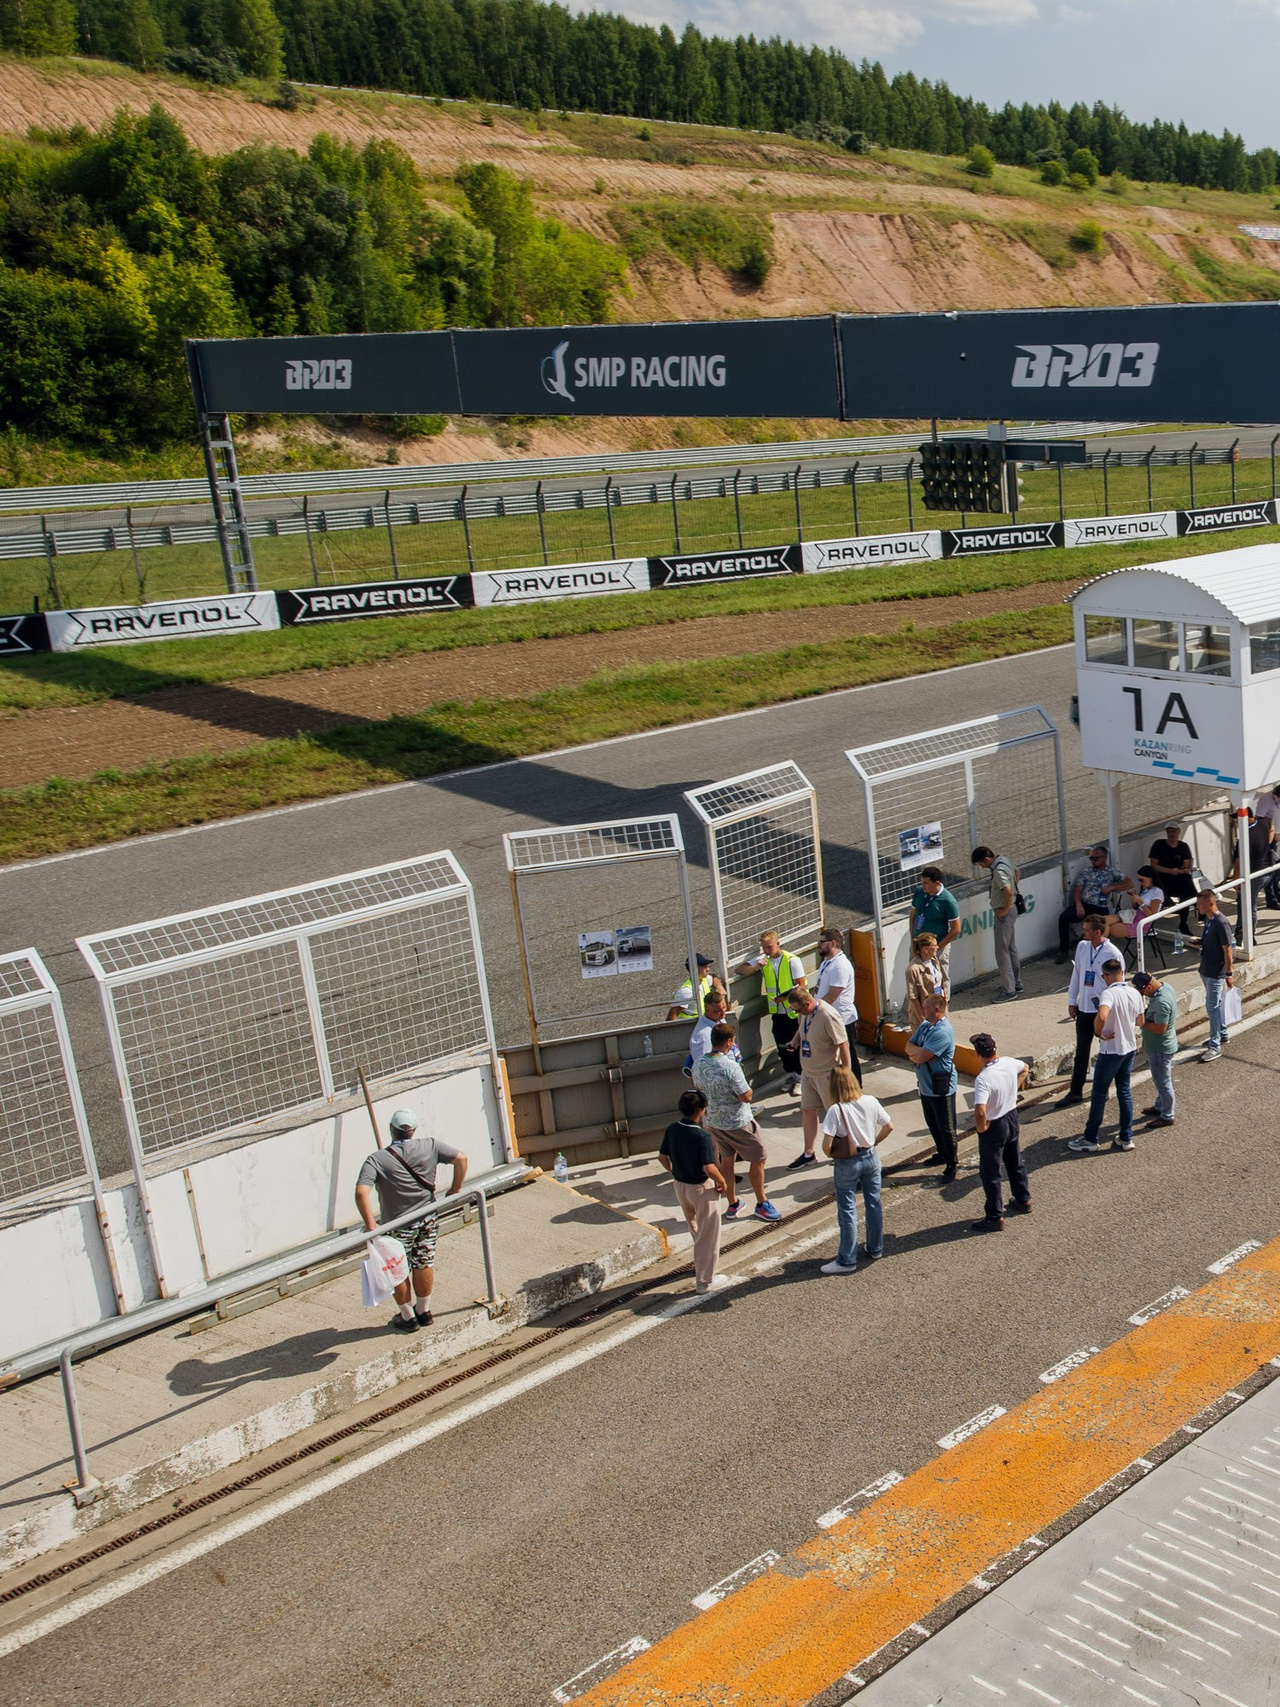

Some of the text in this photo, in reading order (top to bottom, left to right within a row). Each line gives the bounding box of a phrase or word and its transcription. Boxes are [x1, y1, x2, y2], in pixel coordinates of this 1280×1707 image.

[574, 354, 727, 388] SMP RACING
[1194, 508, 1262, 527] RAVENOL
[962, 530, 1046, 549] RAVENOL
[1085, 521, 1159, 538] RAVENOL
[827, 541, 920, 561] RAVENOL
[676, 555, 780, 578] RAVENOL
[505, 571, 621, 593] RAVENOL
[309, 586, 444, 612] RAVENOL
[90, 606, 242, 634] RAVENOL
[1122, 686, 1200, 740] 1A
[1134, 738, 1192, 755] KAZANRING
[1134, 748, 1168, 760] CANYON
